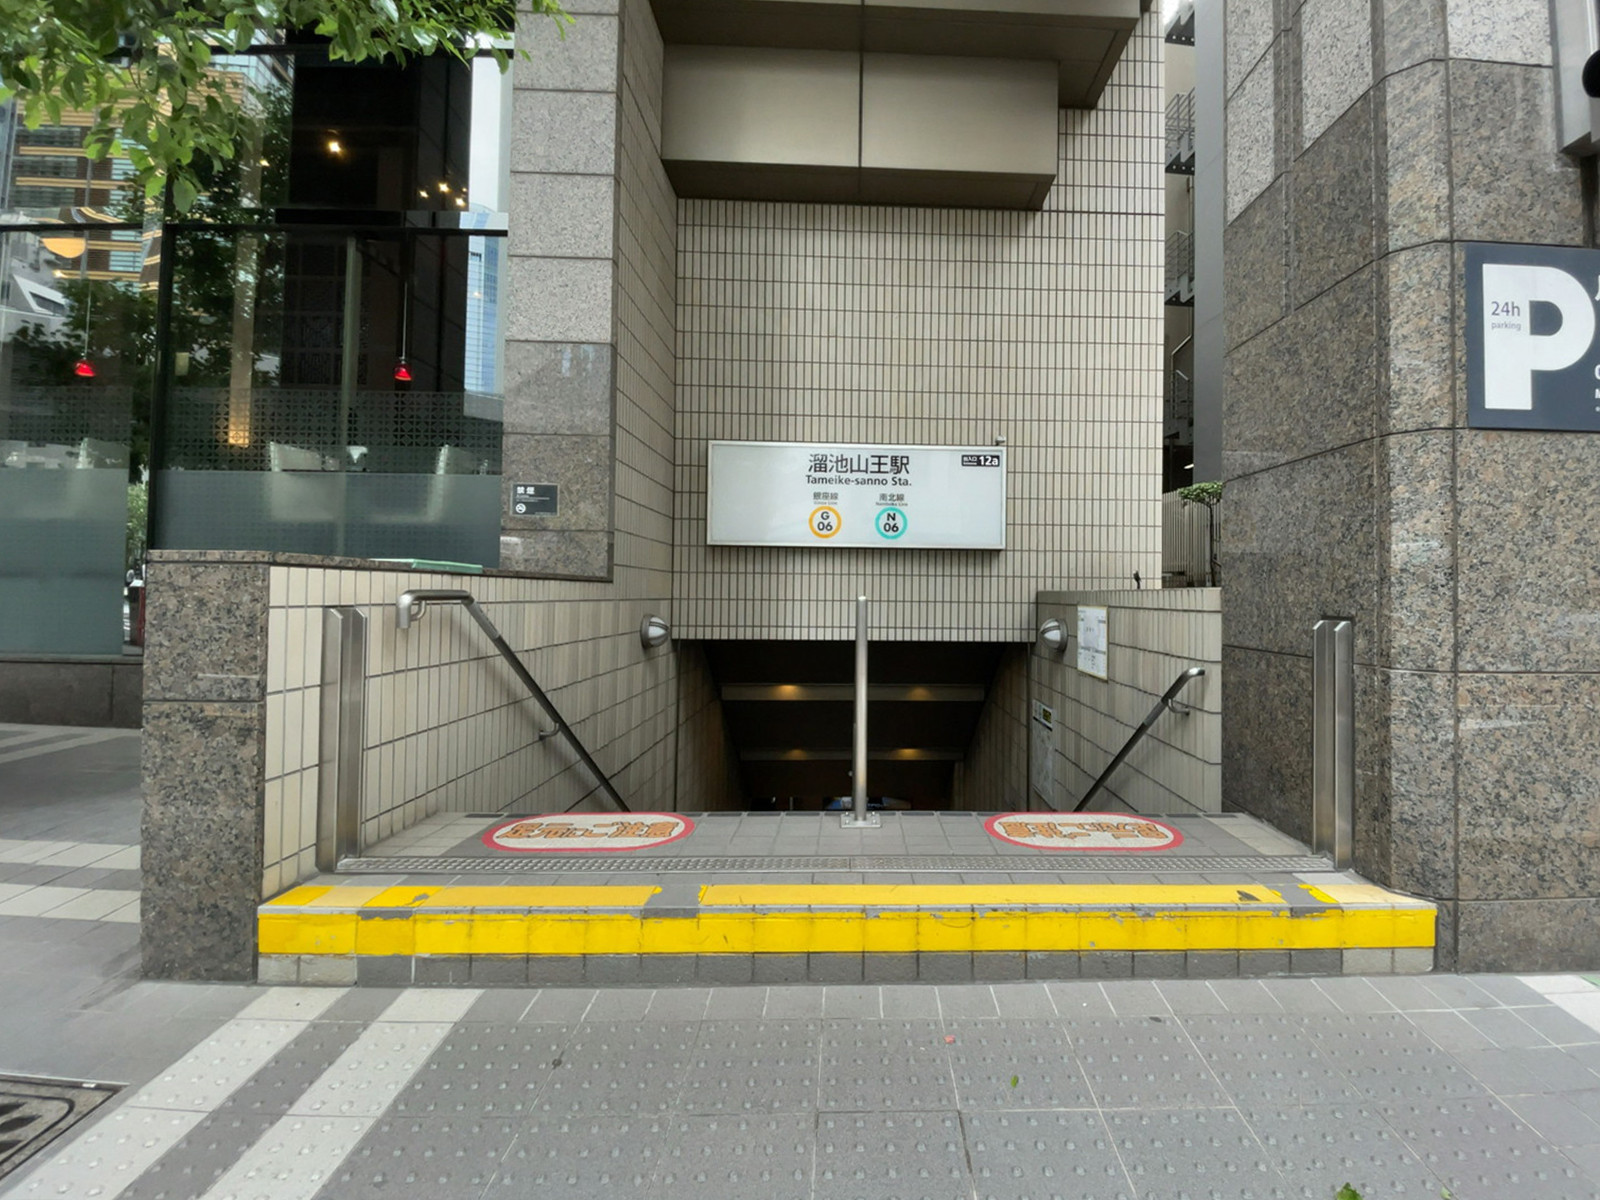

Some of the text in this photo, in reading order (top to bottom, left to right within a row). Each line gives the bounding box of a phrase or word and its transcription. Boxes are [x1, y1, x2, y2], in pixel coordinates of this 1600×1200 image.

[1491, 301, 1521, 317] 24h
[1491, 320, 1522, 332] parking
[1482, 263, 1596, 411] P
[808, 453, 910, 475] 溜池山王駅
[979, 455, 999, 466] 12a
[805, 474, 912, 487] Tameike-sanno Sta.
[813, 492, 839, 501] 銀座線
[879, 493, 905, 502] 南北線
[820, 511, 830, 521] G
[887, 512, 896, 521] N
[817, 521, 834, 532] 06
[883, 522, 900, 533] 06
[496, 821, 680, 839] 足元にご注意
